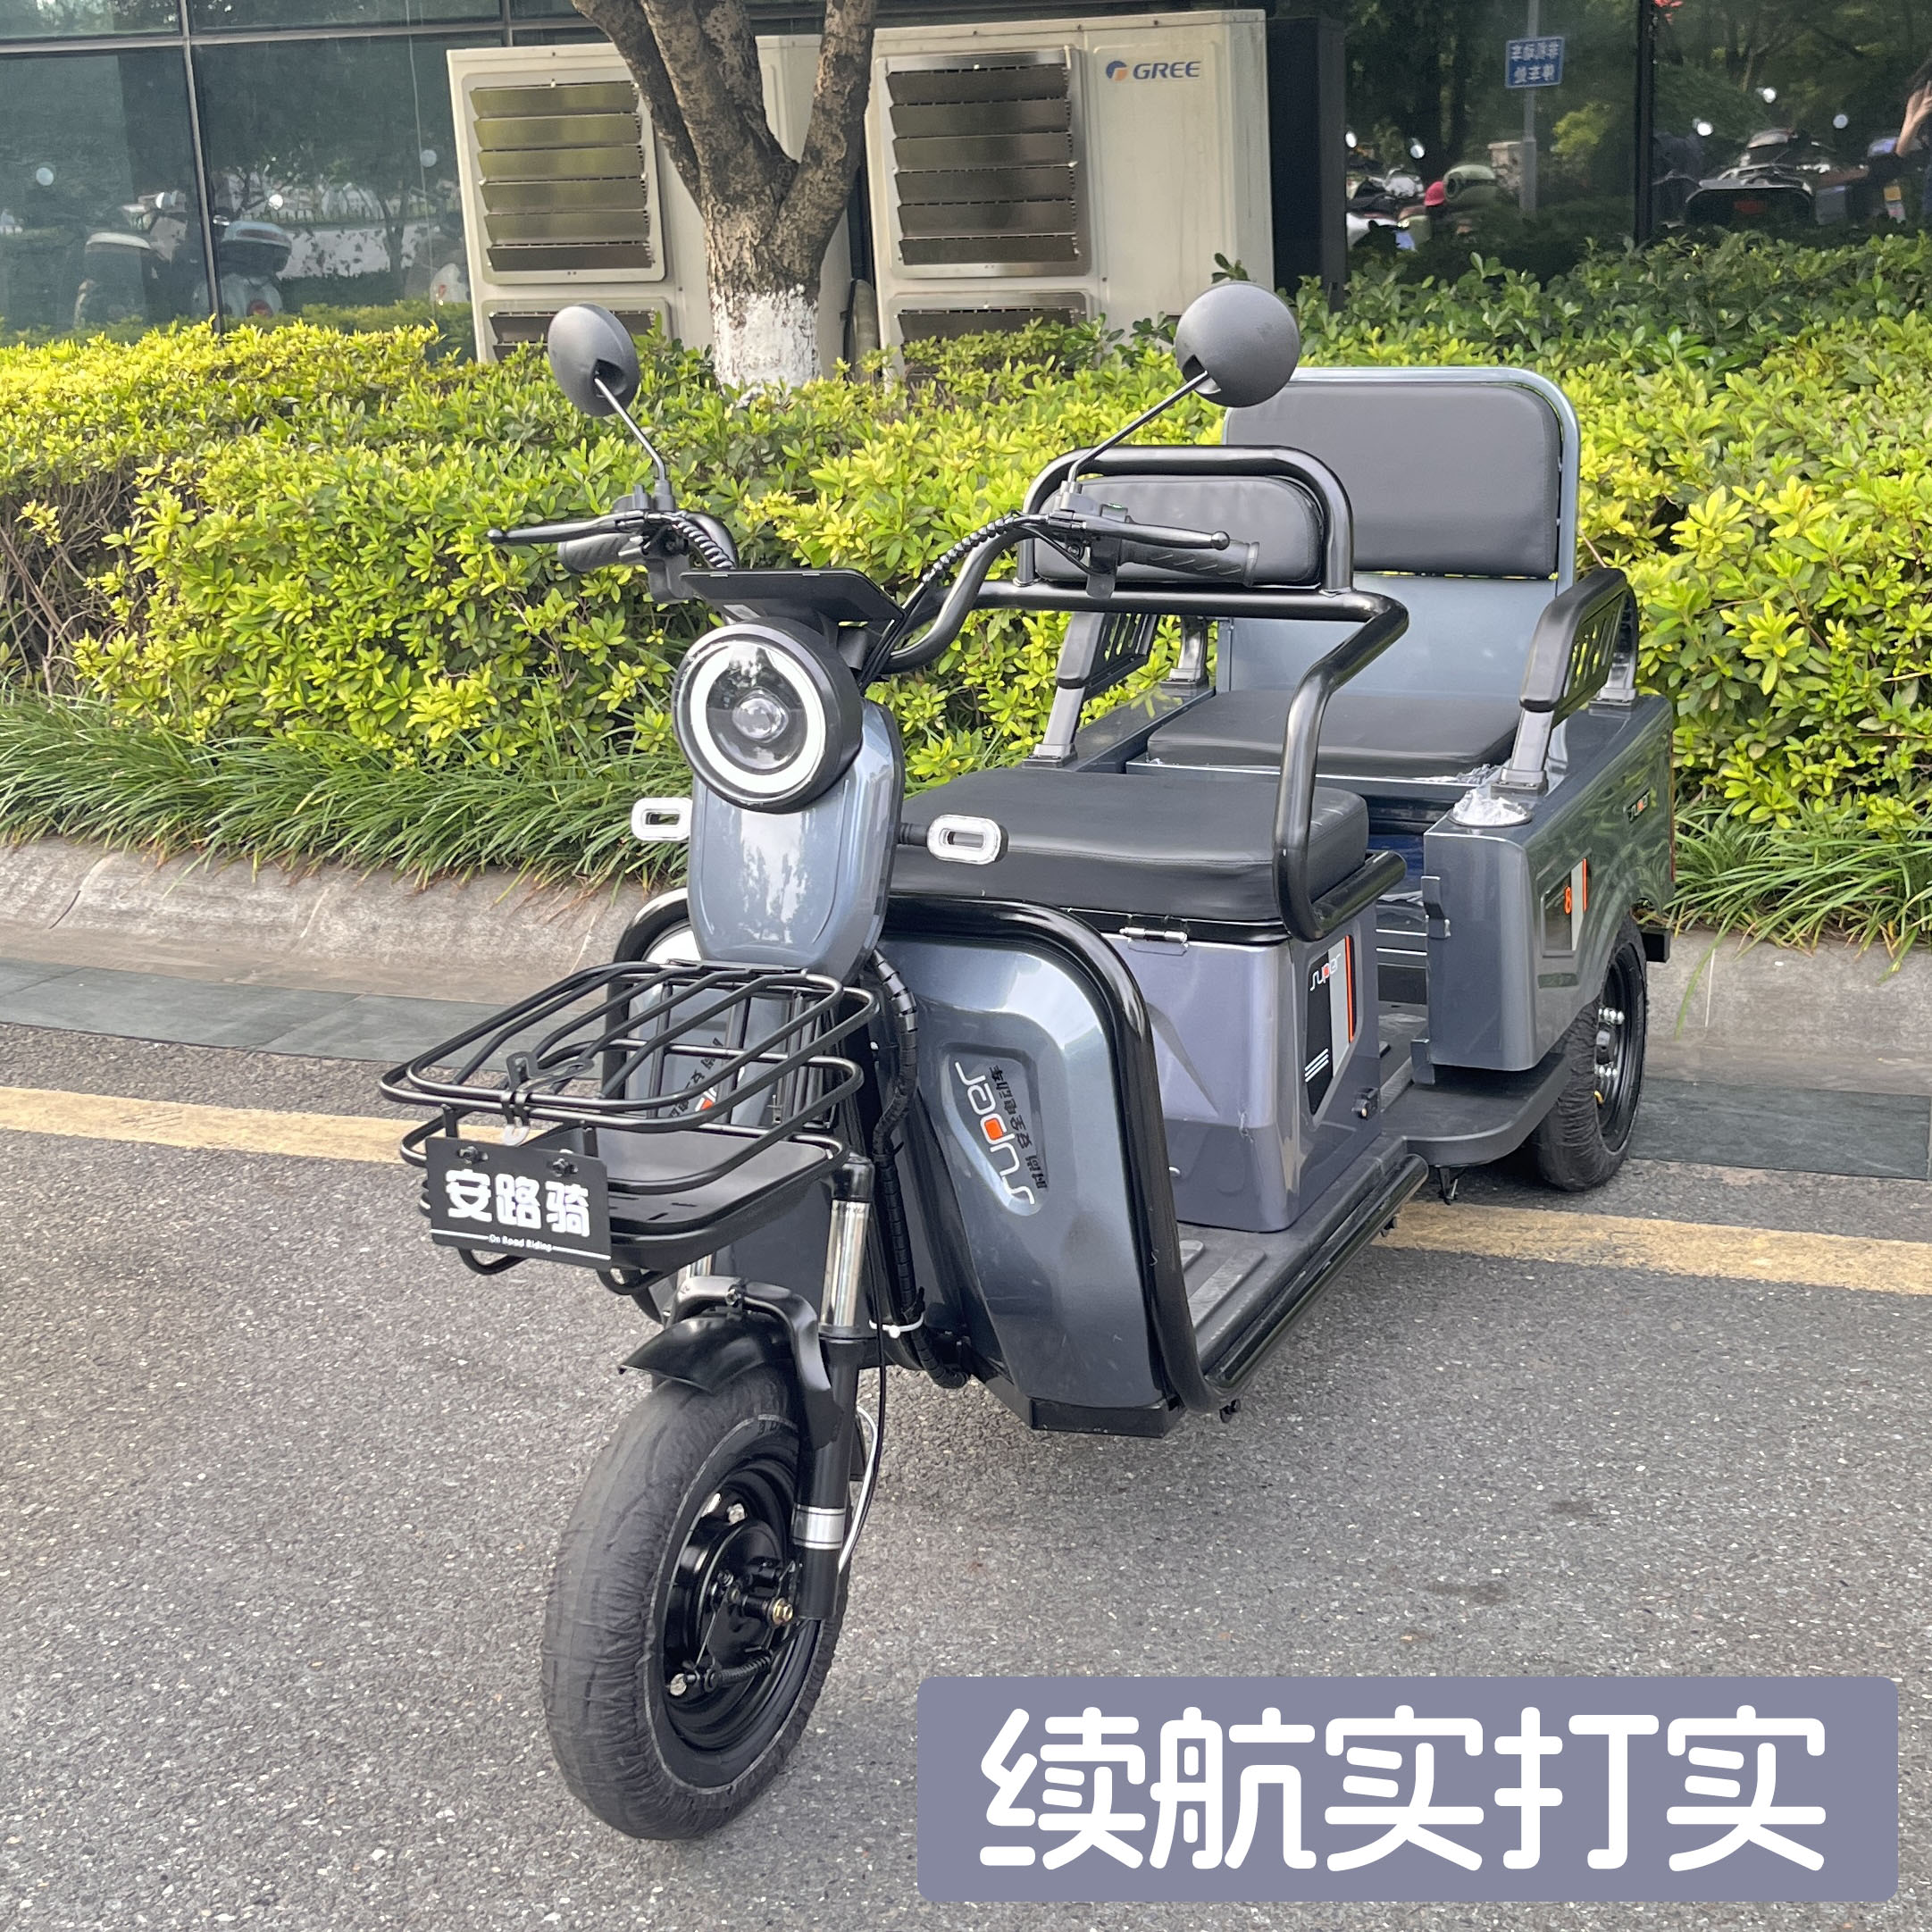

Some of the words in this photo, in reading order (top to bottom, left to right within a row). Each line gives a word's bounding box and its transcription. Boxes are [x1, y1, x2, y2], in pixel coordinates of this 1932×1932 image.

[1133, 61, 1201, 79] GREE
[1309, 952, 1342, 991] super
[989, 1065, 1032, 1150] 安全电动车
[954, 1061, 1036, 1205] super
[1025, 1154, 1049, 1189] 时尚
[445, 1168, 591, 1238] 安路骑
[489, 1234, 500, 1244] On
[502, 1235, 525, 1248] Road
[526, 1239, 553, 1252] Riding
